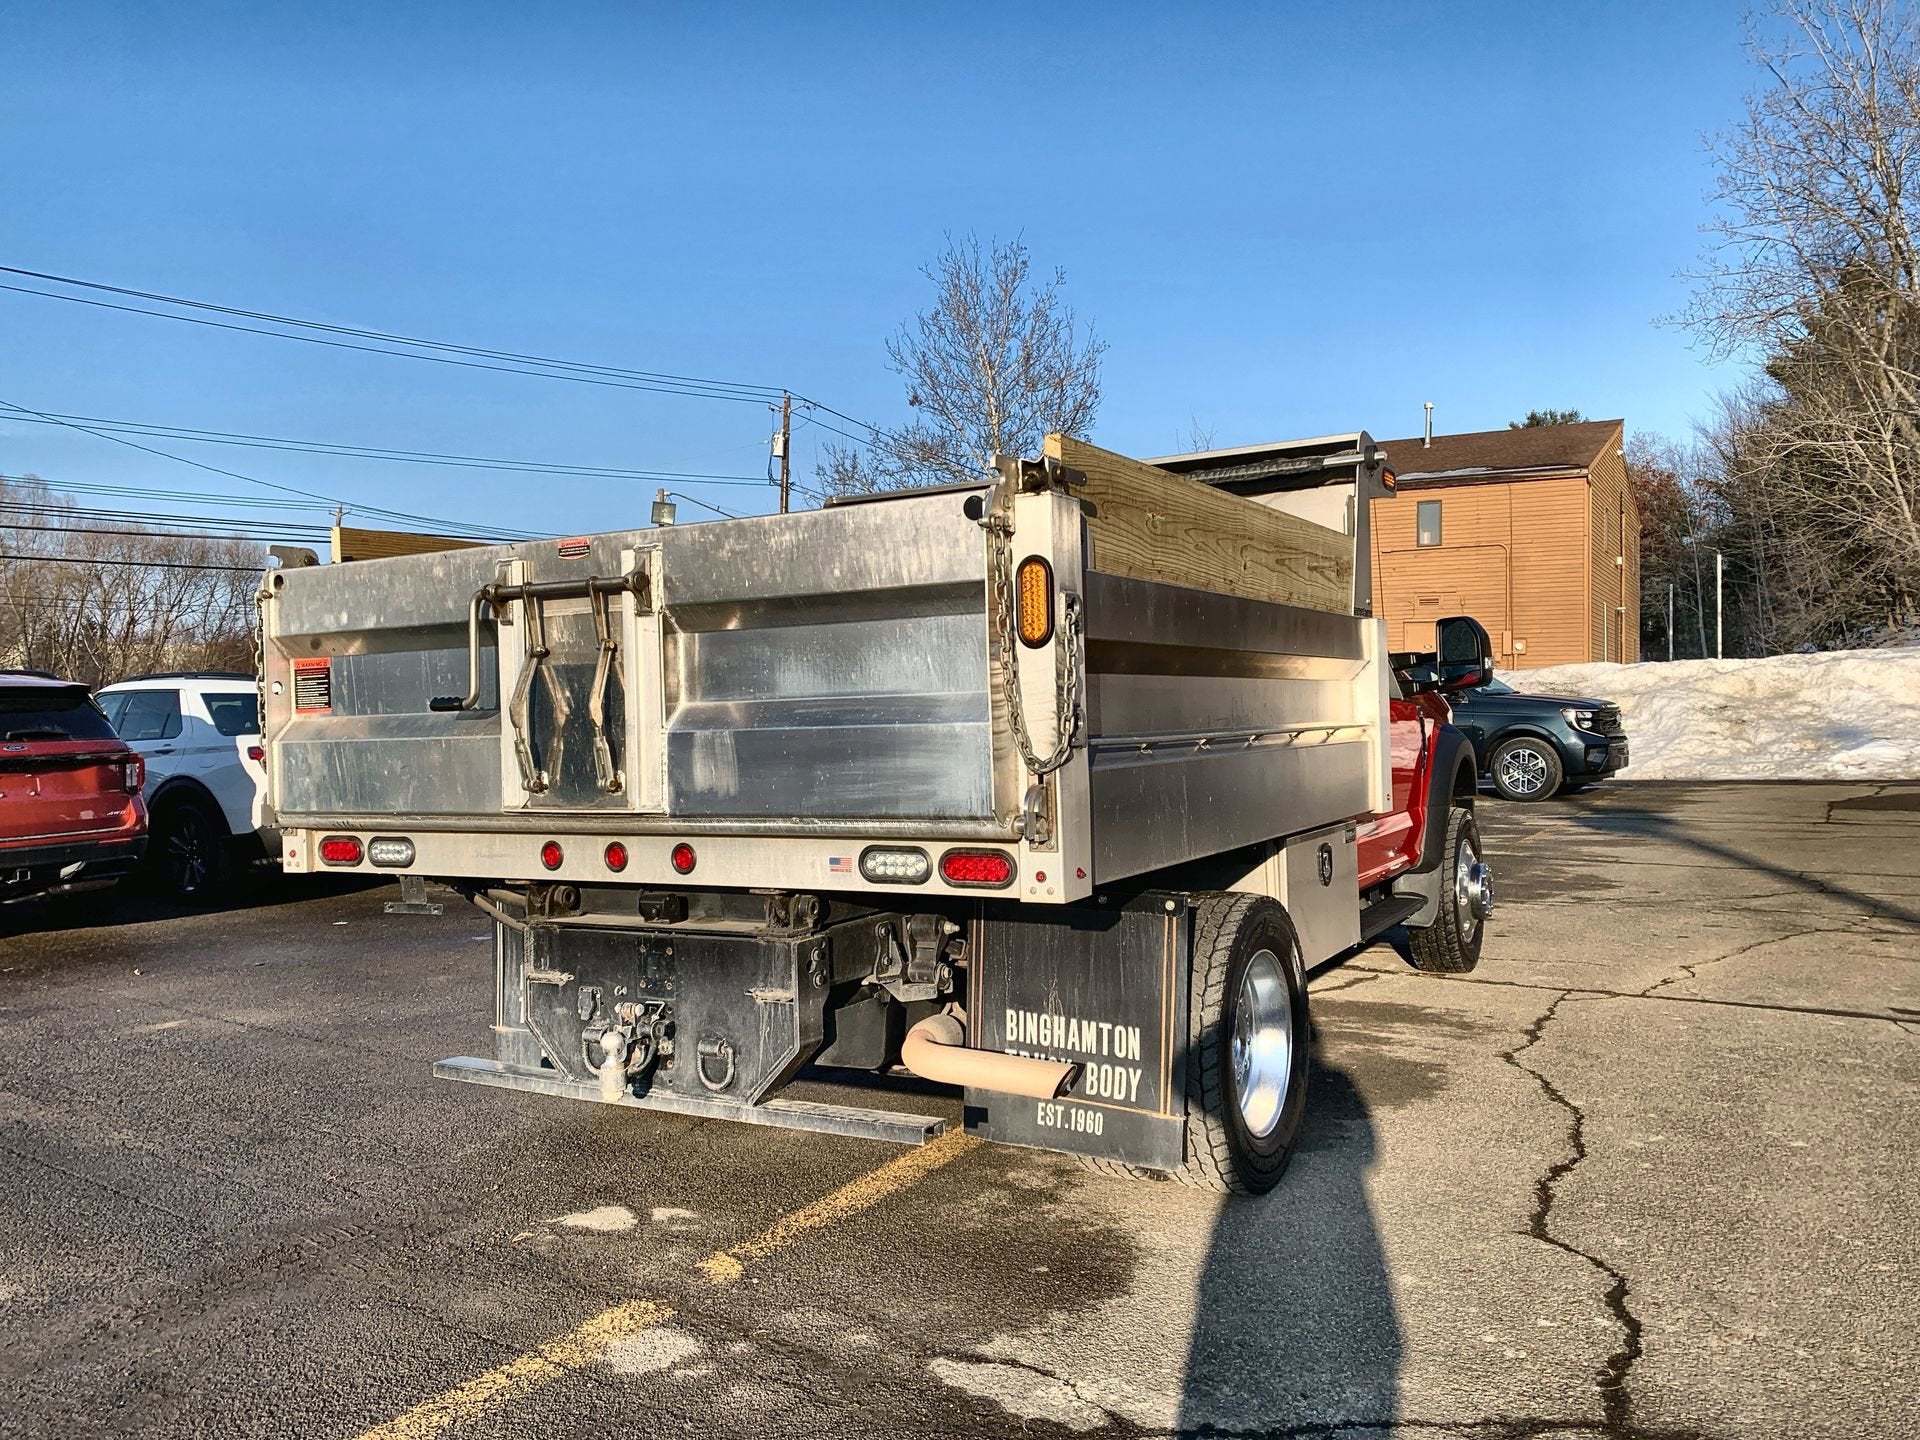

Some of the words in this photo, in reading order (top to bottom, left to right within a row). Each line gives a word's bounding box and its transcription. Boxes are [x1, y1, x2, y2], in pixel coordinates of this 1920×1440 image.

[1005, 1009, 1141, 1061] BINGHAMTON
[1085, 1061, 1143, 1102] BODY
[1037, 1102, 1104, 1136] EST.1960
